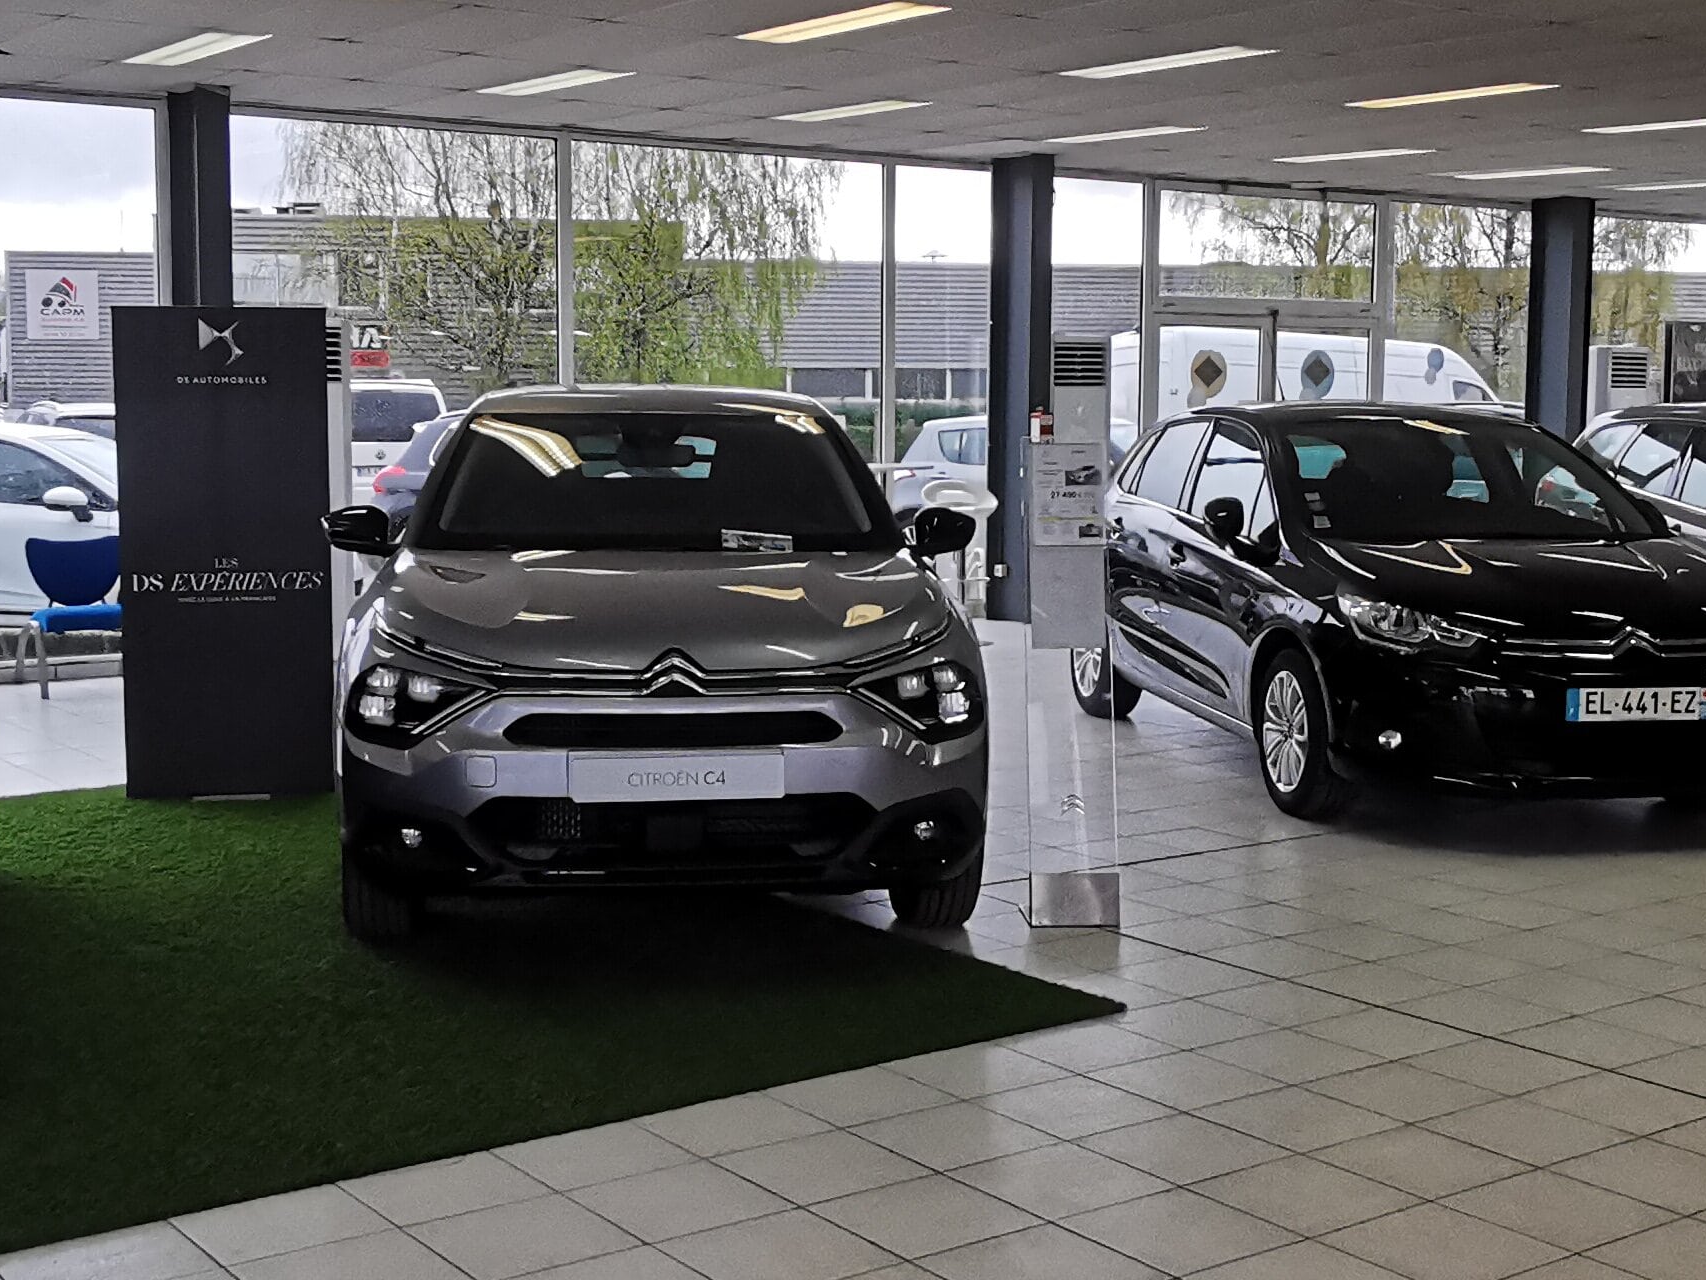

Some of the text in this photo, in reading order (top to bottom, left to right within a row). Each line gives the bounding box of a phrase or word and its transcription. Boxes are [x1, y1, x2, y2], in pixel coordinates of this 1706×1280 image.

[192, 376, 267, 384] AUTOMOBILES
[214, 557, 239, 569] LES
[132, 570, 324, 592] DS EXPÉRIENCES
[703, 770, 726, 786] C4
